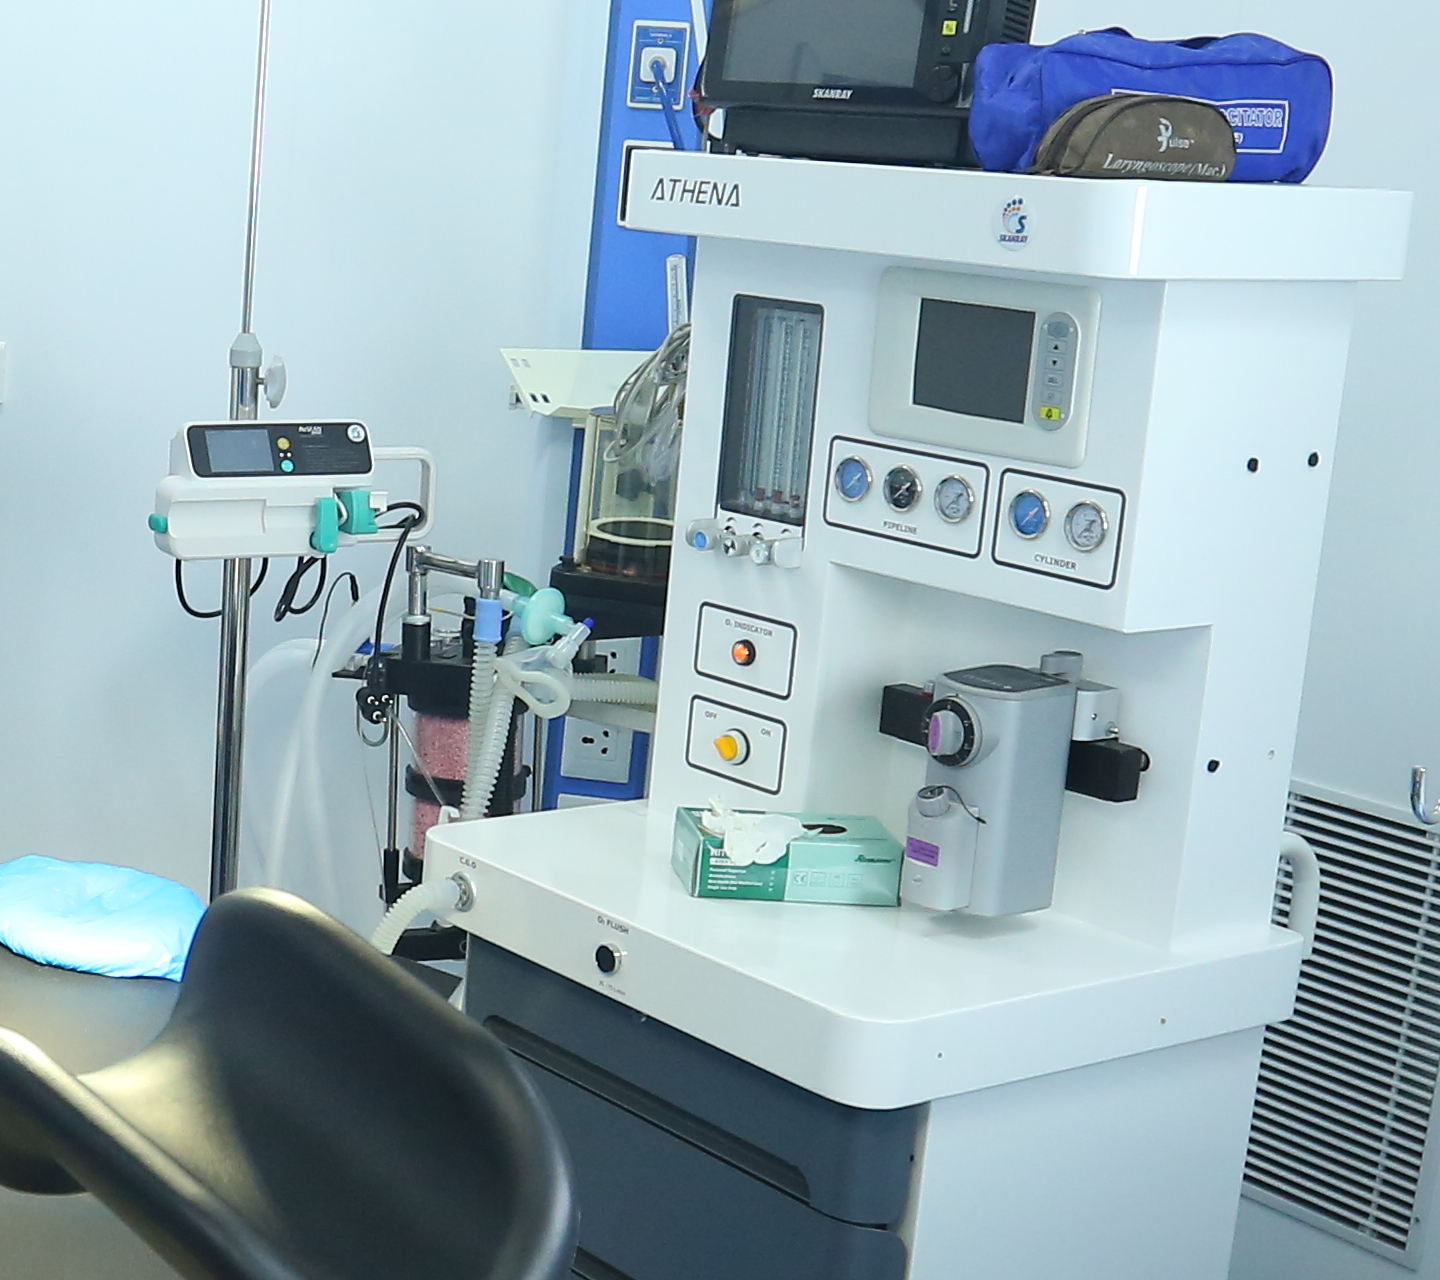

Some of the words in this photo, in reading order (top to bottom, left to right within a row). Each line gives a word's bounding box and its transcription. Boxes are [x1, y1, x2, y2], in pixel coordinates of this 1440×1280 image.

[812, 88, 853, 99] SKANRAY
[650, 177, 741, 207] ATHENA
[883, 521, 917, 534] PIPELINE
[1034, 554, 1076, 570] CYLINDER
[734, 621, 773, 637] INDICATOR
[705, 711, 717, 719] OFF
[761, 728, 772, 737] ON
[606, 920, 629, 935] FLUSH
